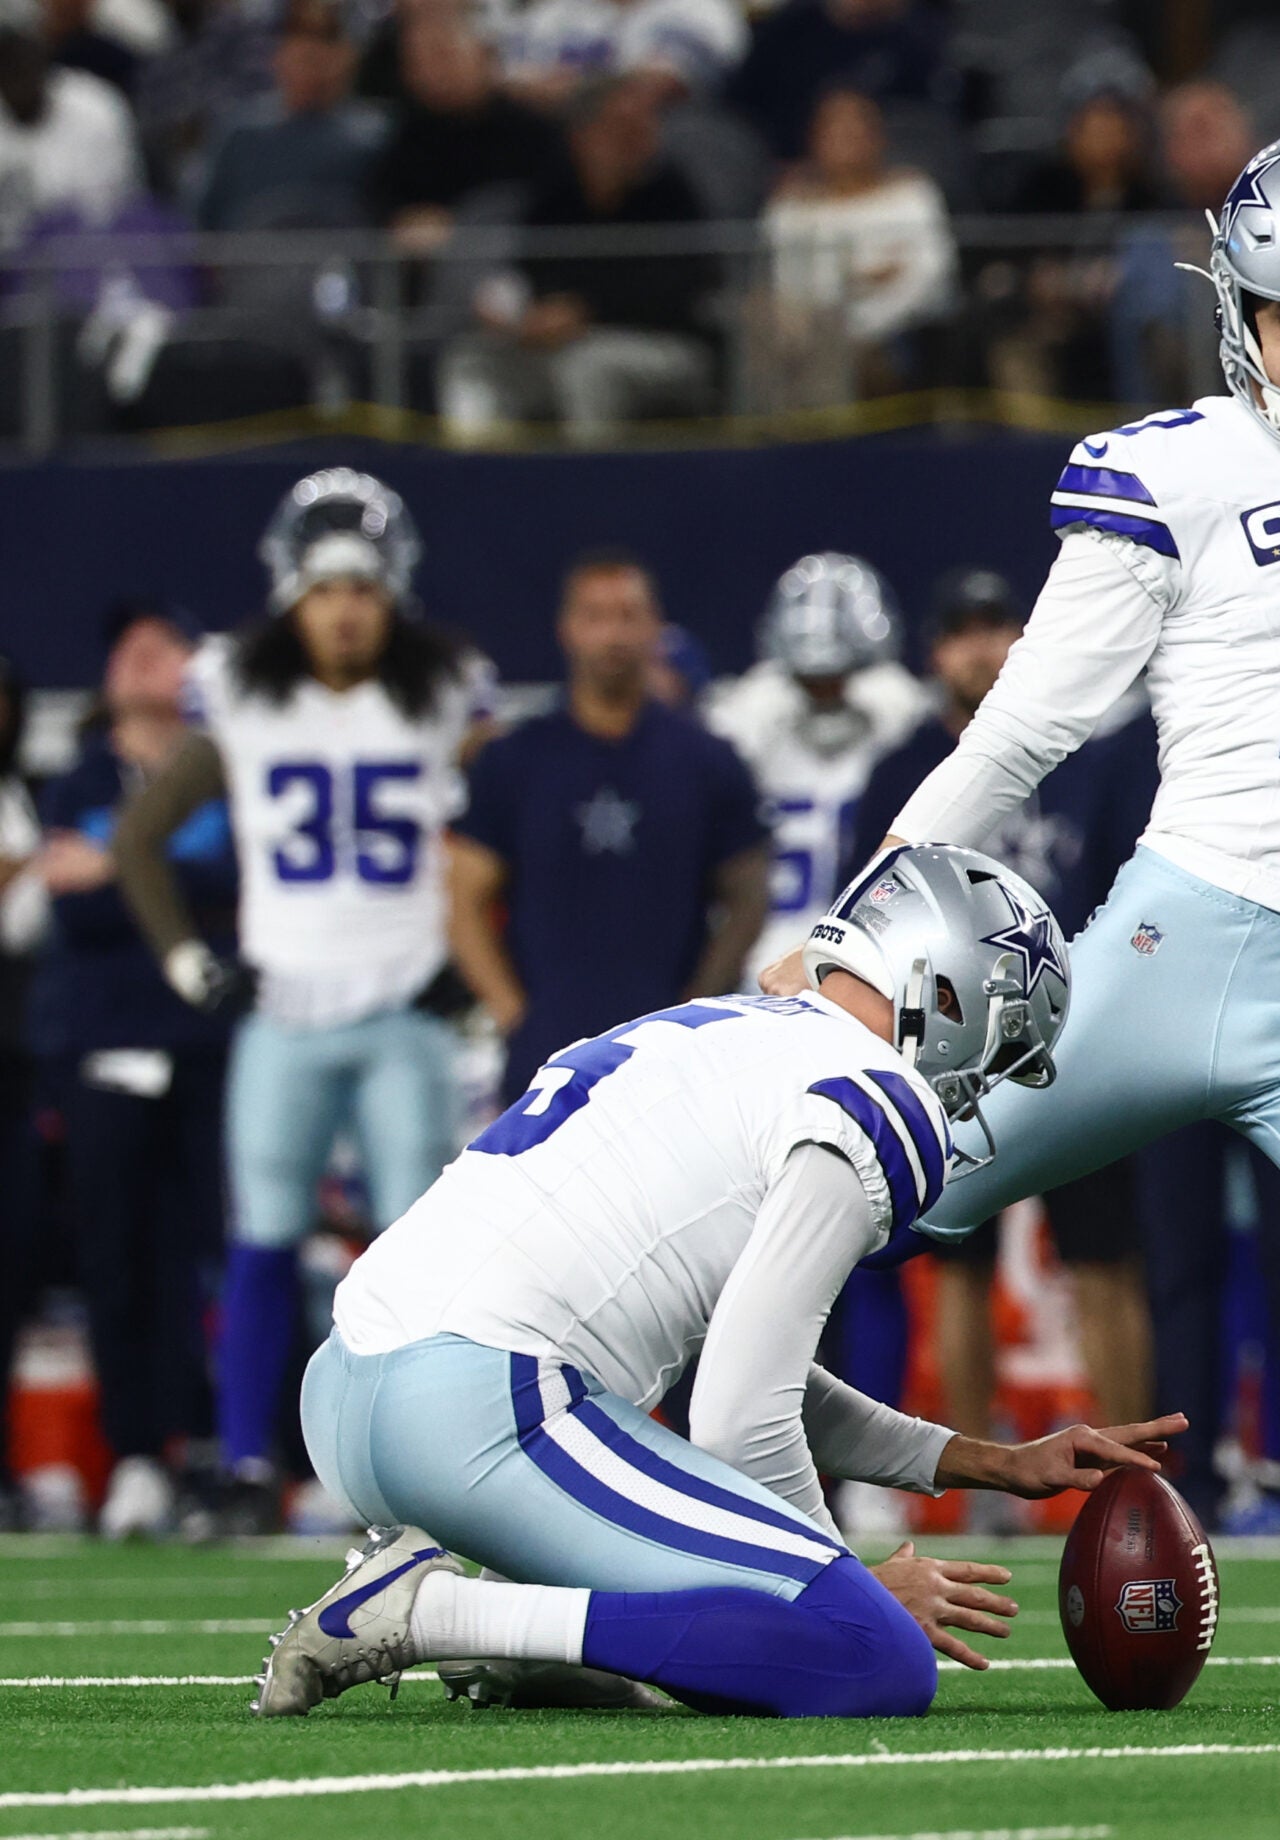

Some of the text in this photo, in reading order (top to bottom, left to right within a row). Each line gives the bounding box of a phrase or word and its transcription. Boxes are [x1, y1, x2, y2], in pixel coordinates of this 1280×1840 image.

[267, 762, 423, 885] 35
[467, 1003, 747, 1157] 5
[1124, 1586, 1156, 1628] NFL
